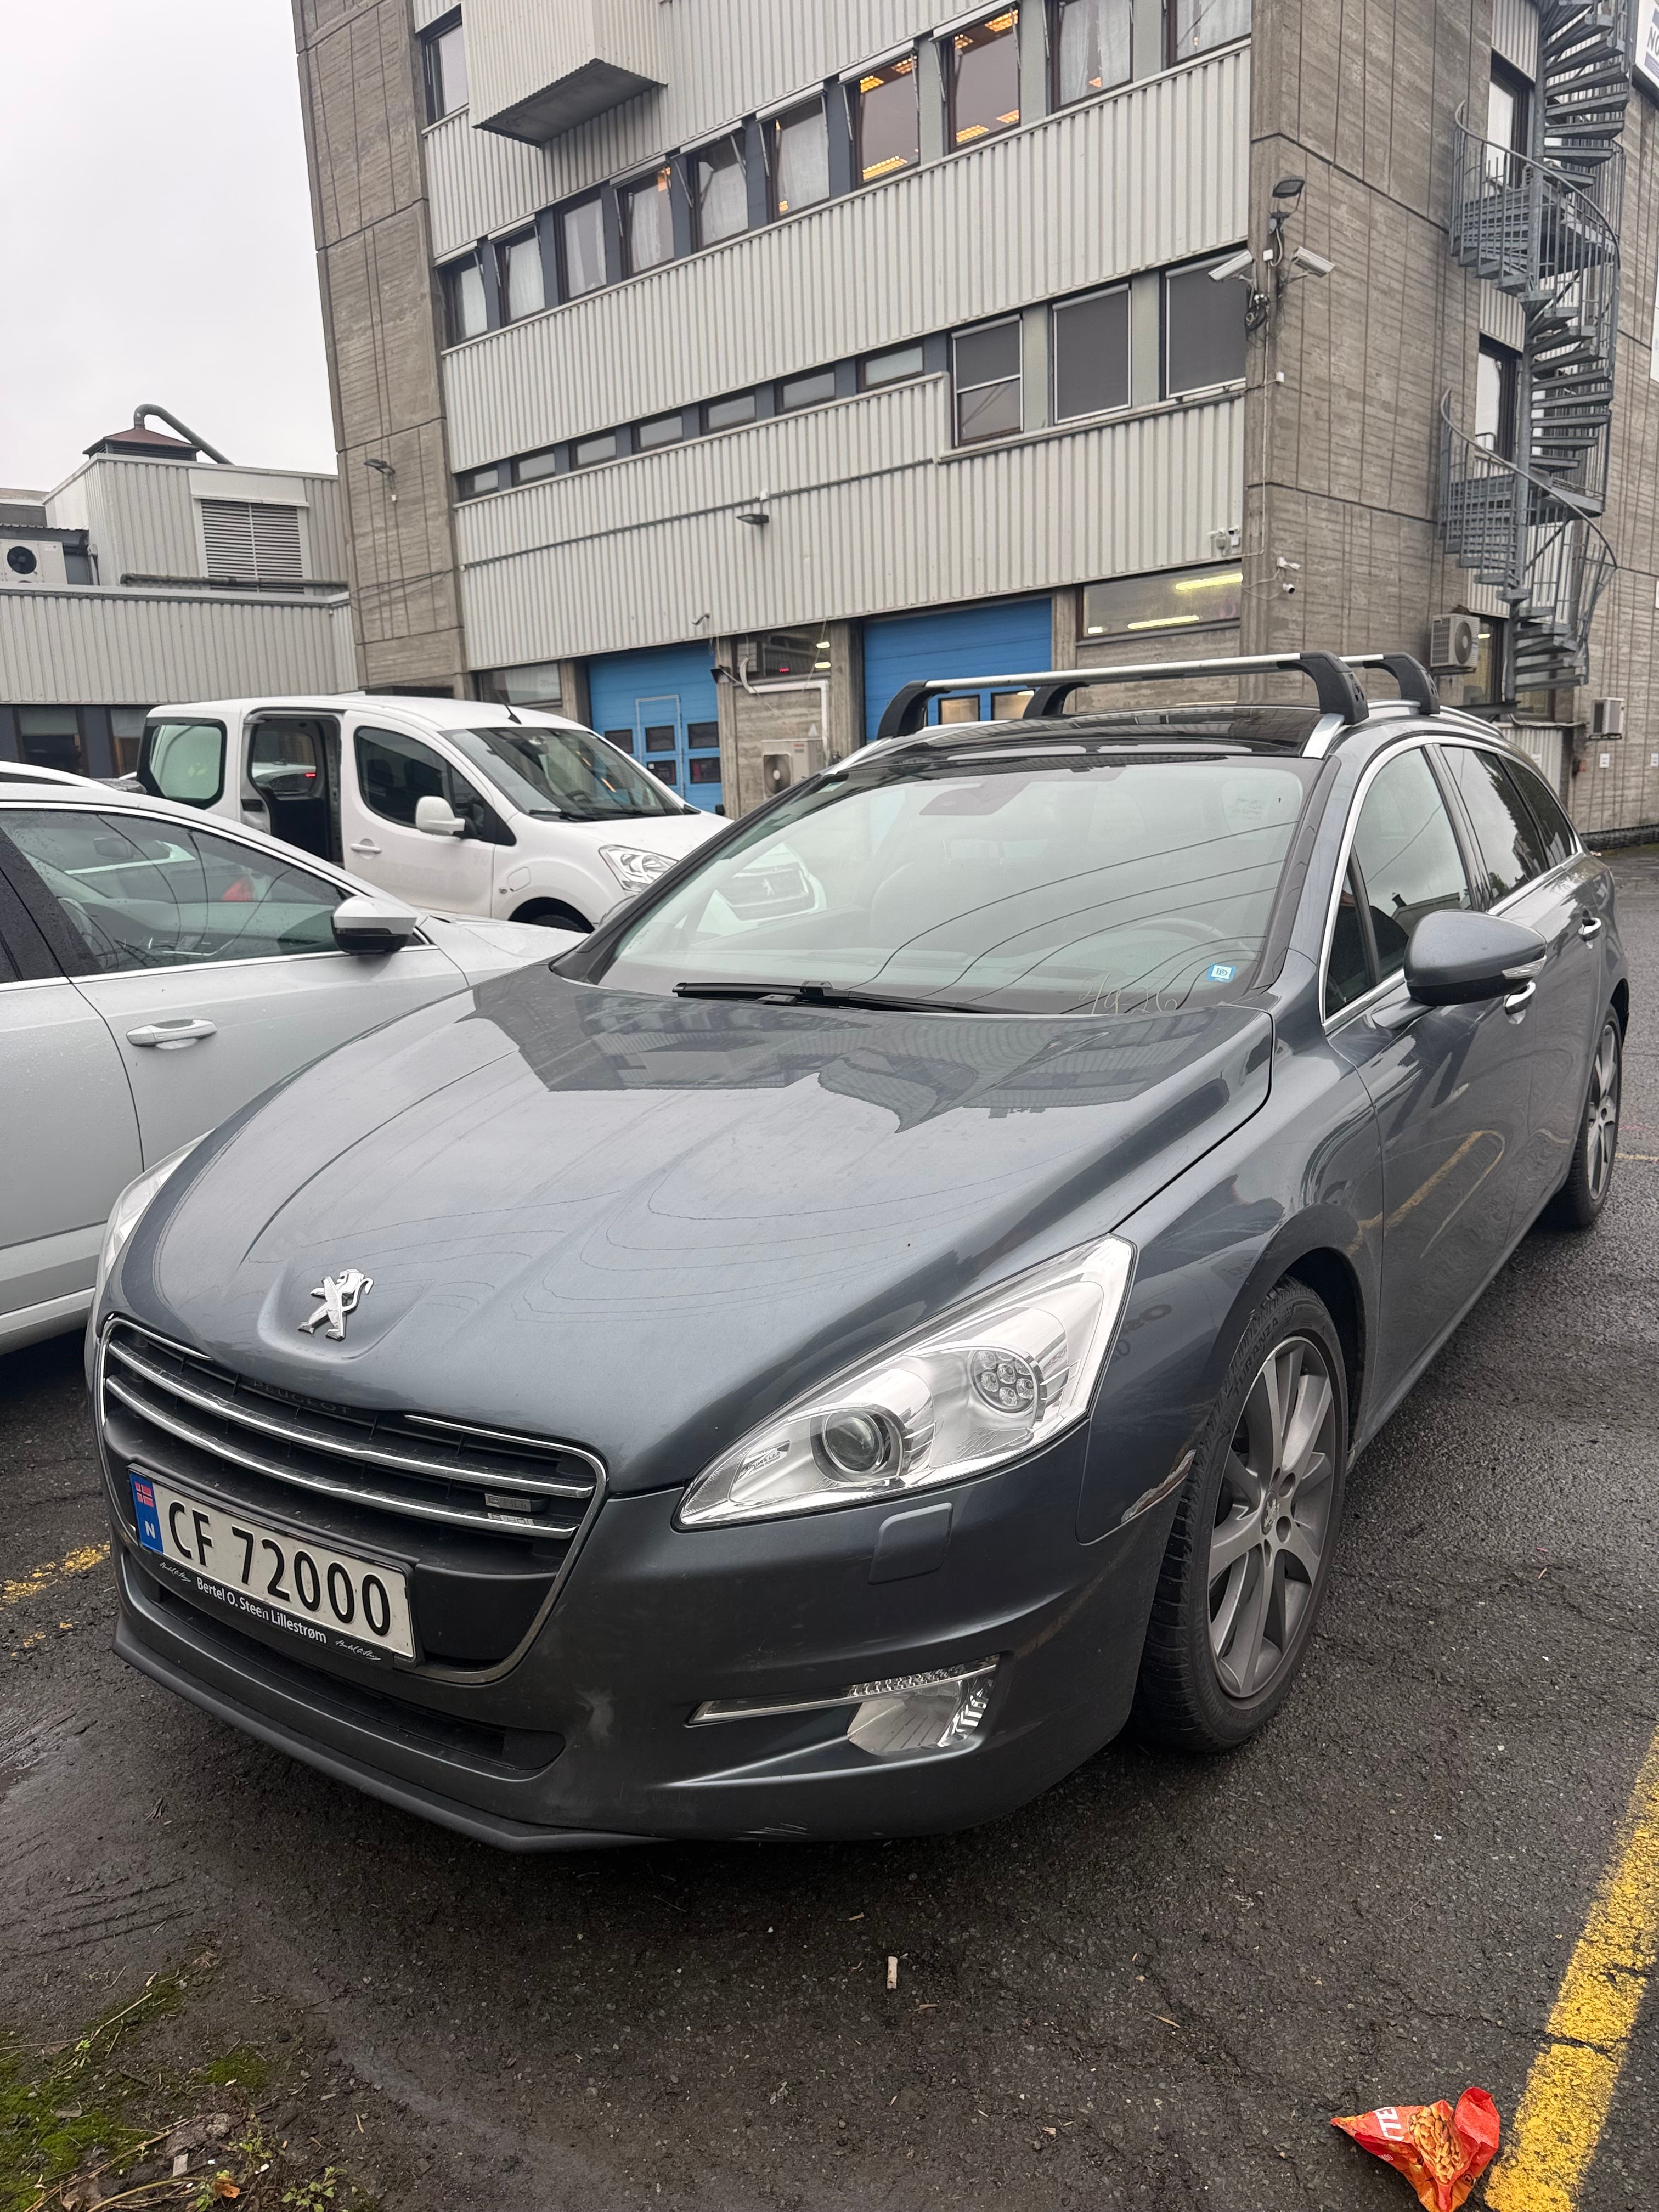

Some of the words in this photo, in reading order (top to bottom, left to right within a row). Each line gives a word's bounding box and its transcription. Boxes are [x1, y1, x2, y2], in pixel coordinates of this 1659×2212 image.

[1228, 1317, 1279, 1398] TURANZA
[253, 1379, 352, 1414] PEUGEOT
[144, 1521, 156, 1539] N
[168, 1500, 213, 1566] CF
[232, 1524, 391, 1637] 72000
[196, 1576, 225, 1601] Bertel
[227, 1592, 238, 1607] O.
[240, 1597, 269, 1621] Steen
[271, 1610, 327, 1644] Lillestrøm
